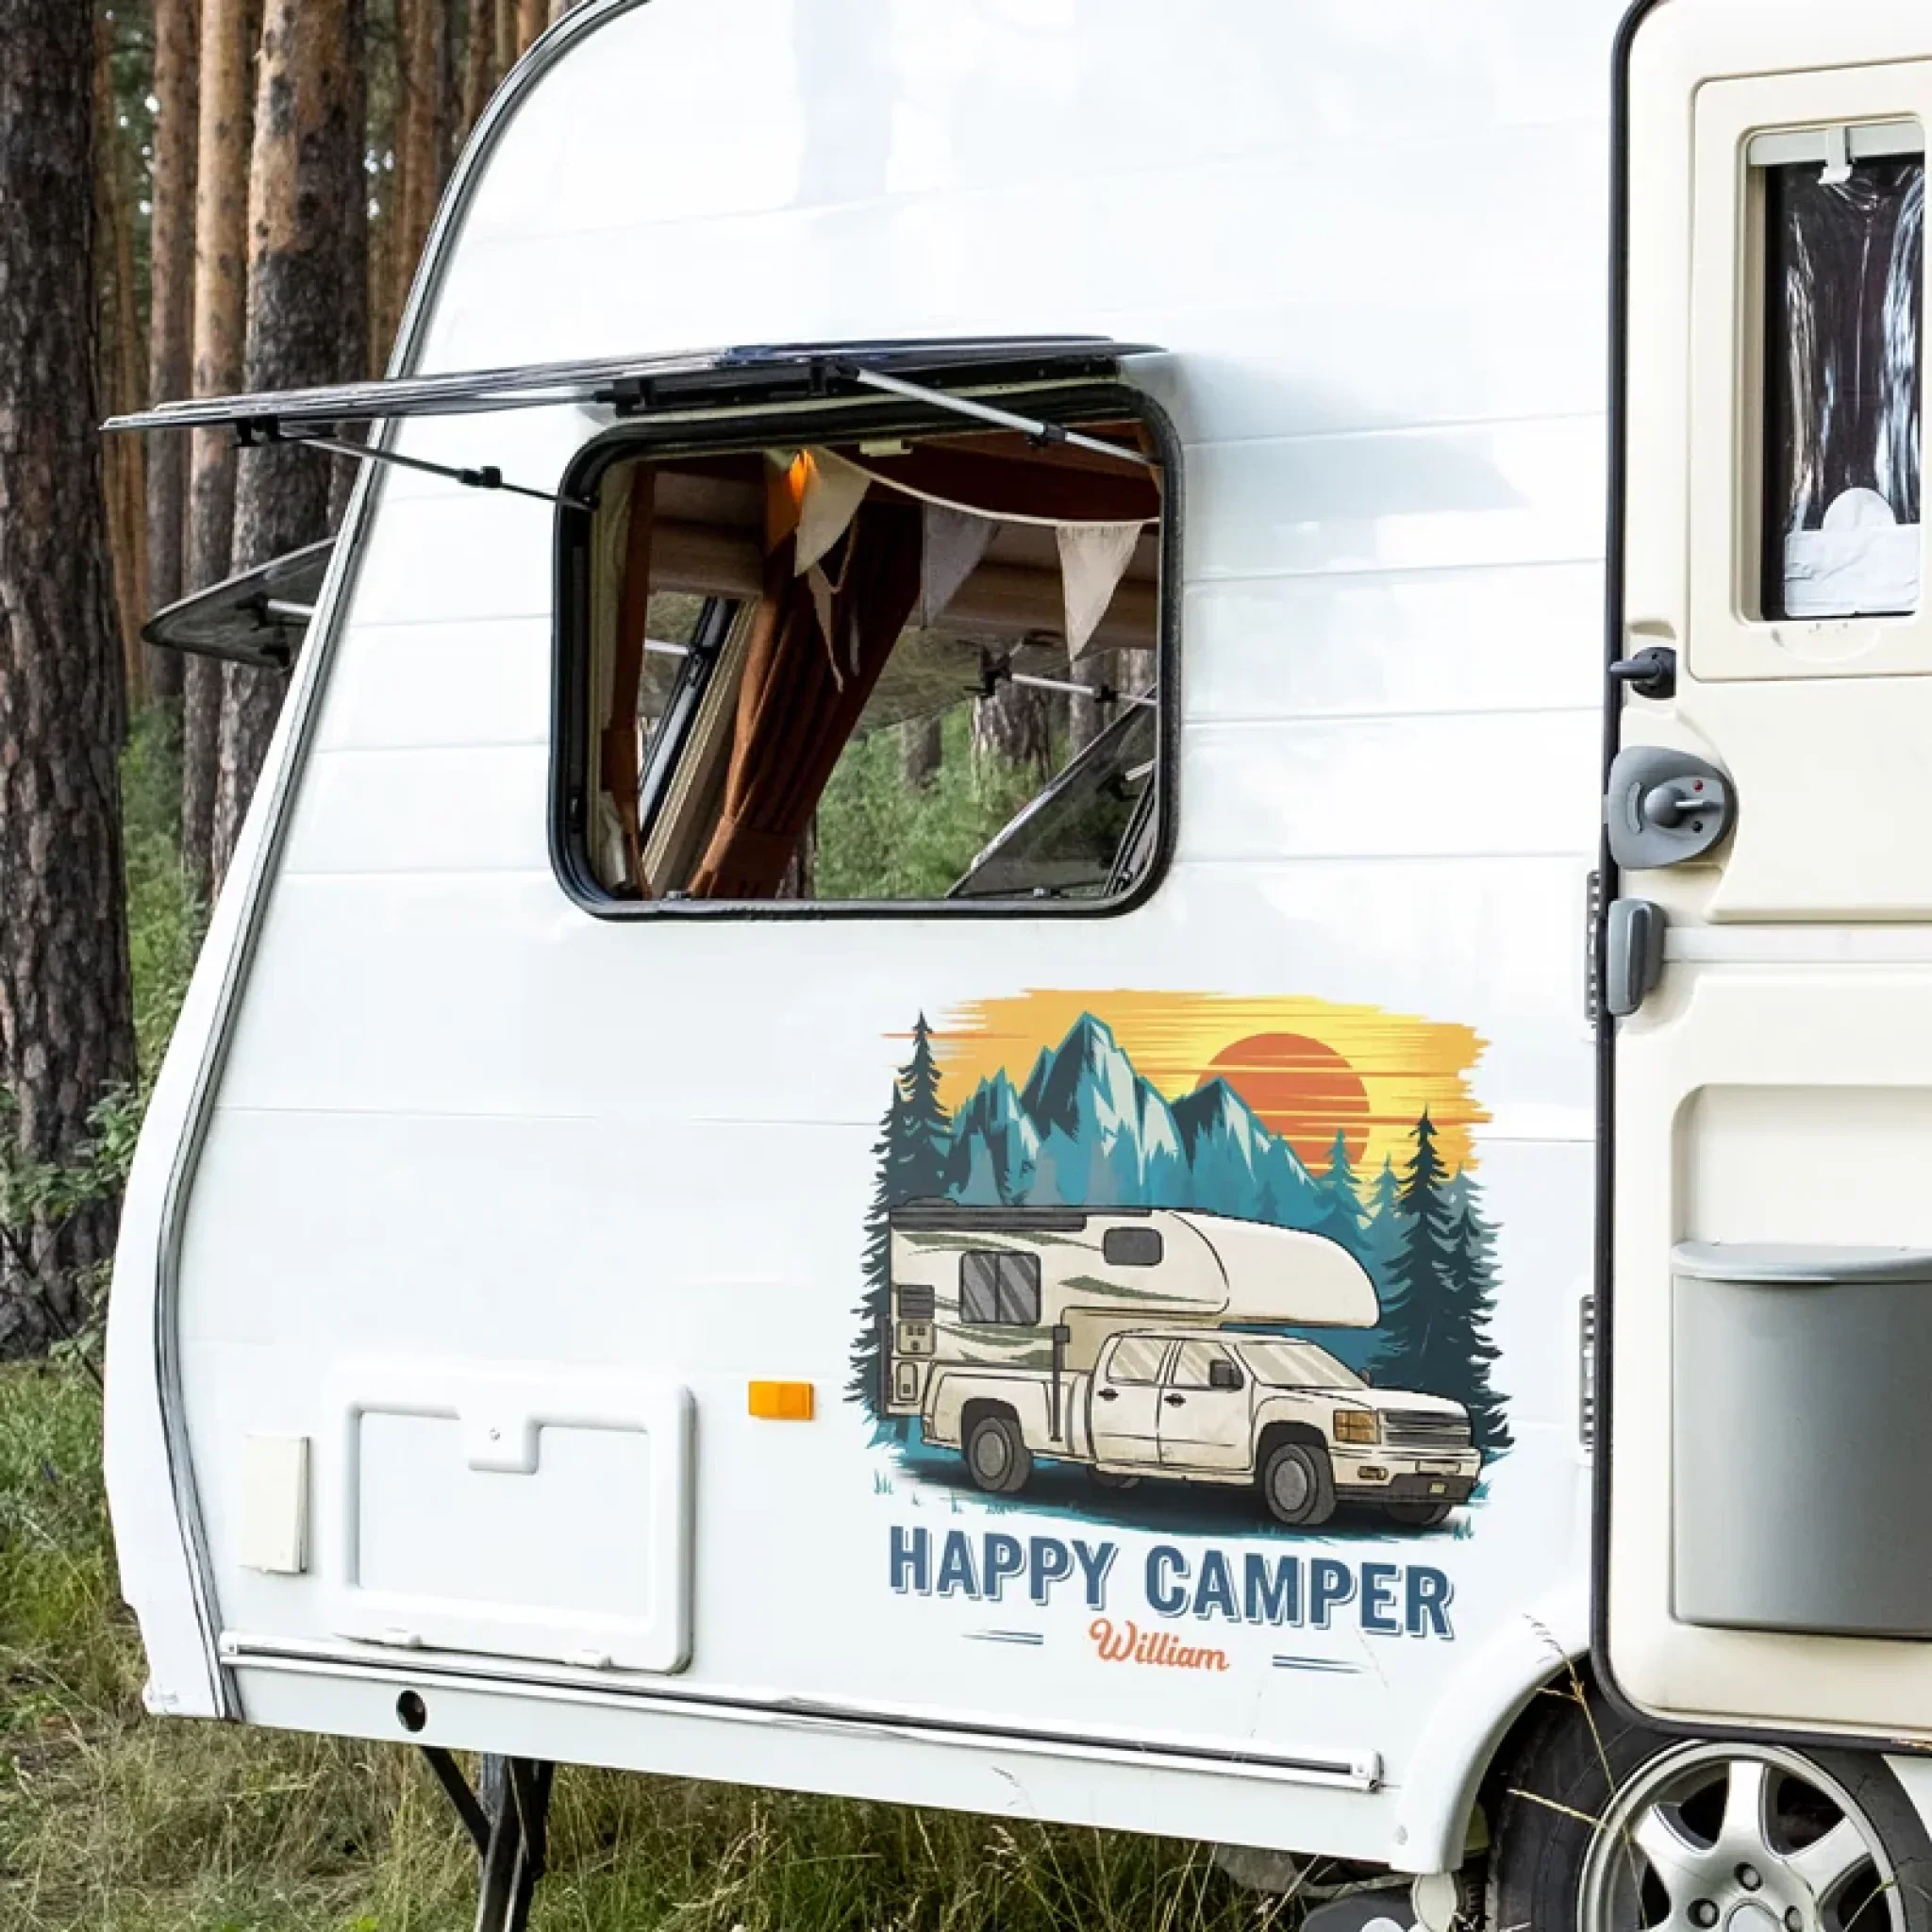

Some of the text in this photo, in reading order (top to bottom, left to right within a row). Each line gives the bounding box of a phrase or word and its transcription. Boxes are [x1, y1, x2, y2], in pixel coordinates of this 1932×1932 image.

[889, 1525, 1455, 1640] HAPPY CAMPER
[1089, 1617, 1230, 1672] William
